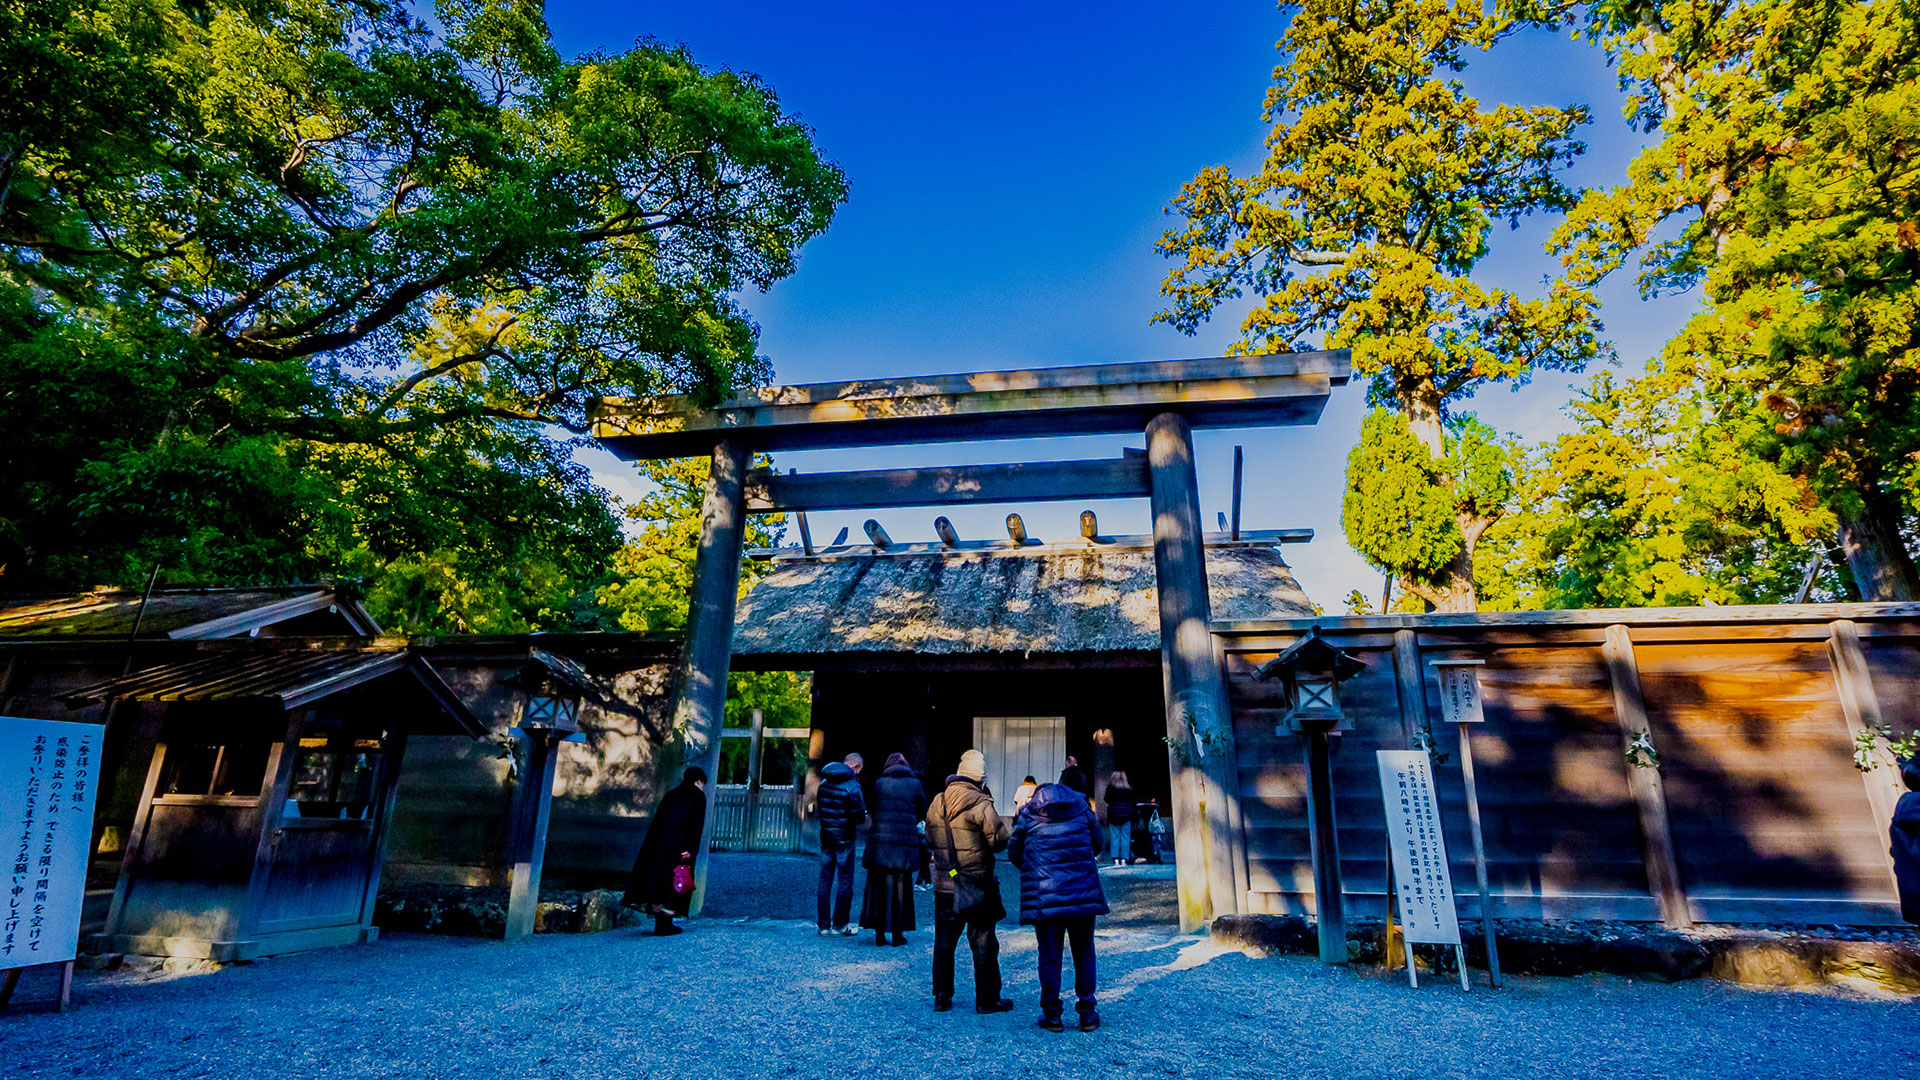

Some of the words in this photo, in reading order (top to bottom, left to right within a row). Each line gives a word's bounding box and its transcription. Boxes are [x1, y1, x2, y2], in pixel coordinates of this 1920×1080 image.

[48, 736, 69, 813] 感染防止のため
[71, 735, 93, 812] ご参拝の皆様へ
[1397, 772, 1410, 815] 午前八時半
[1408, 840, 1424, 904] 午後四時半まで
[2, 735, 47, 957] お参りいただきますようお願い申し上げます
[29, 821, 59, 951] できる限り間隔を空けて
